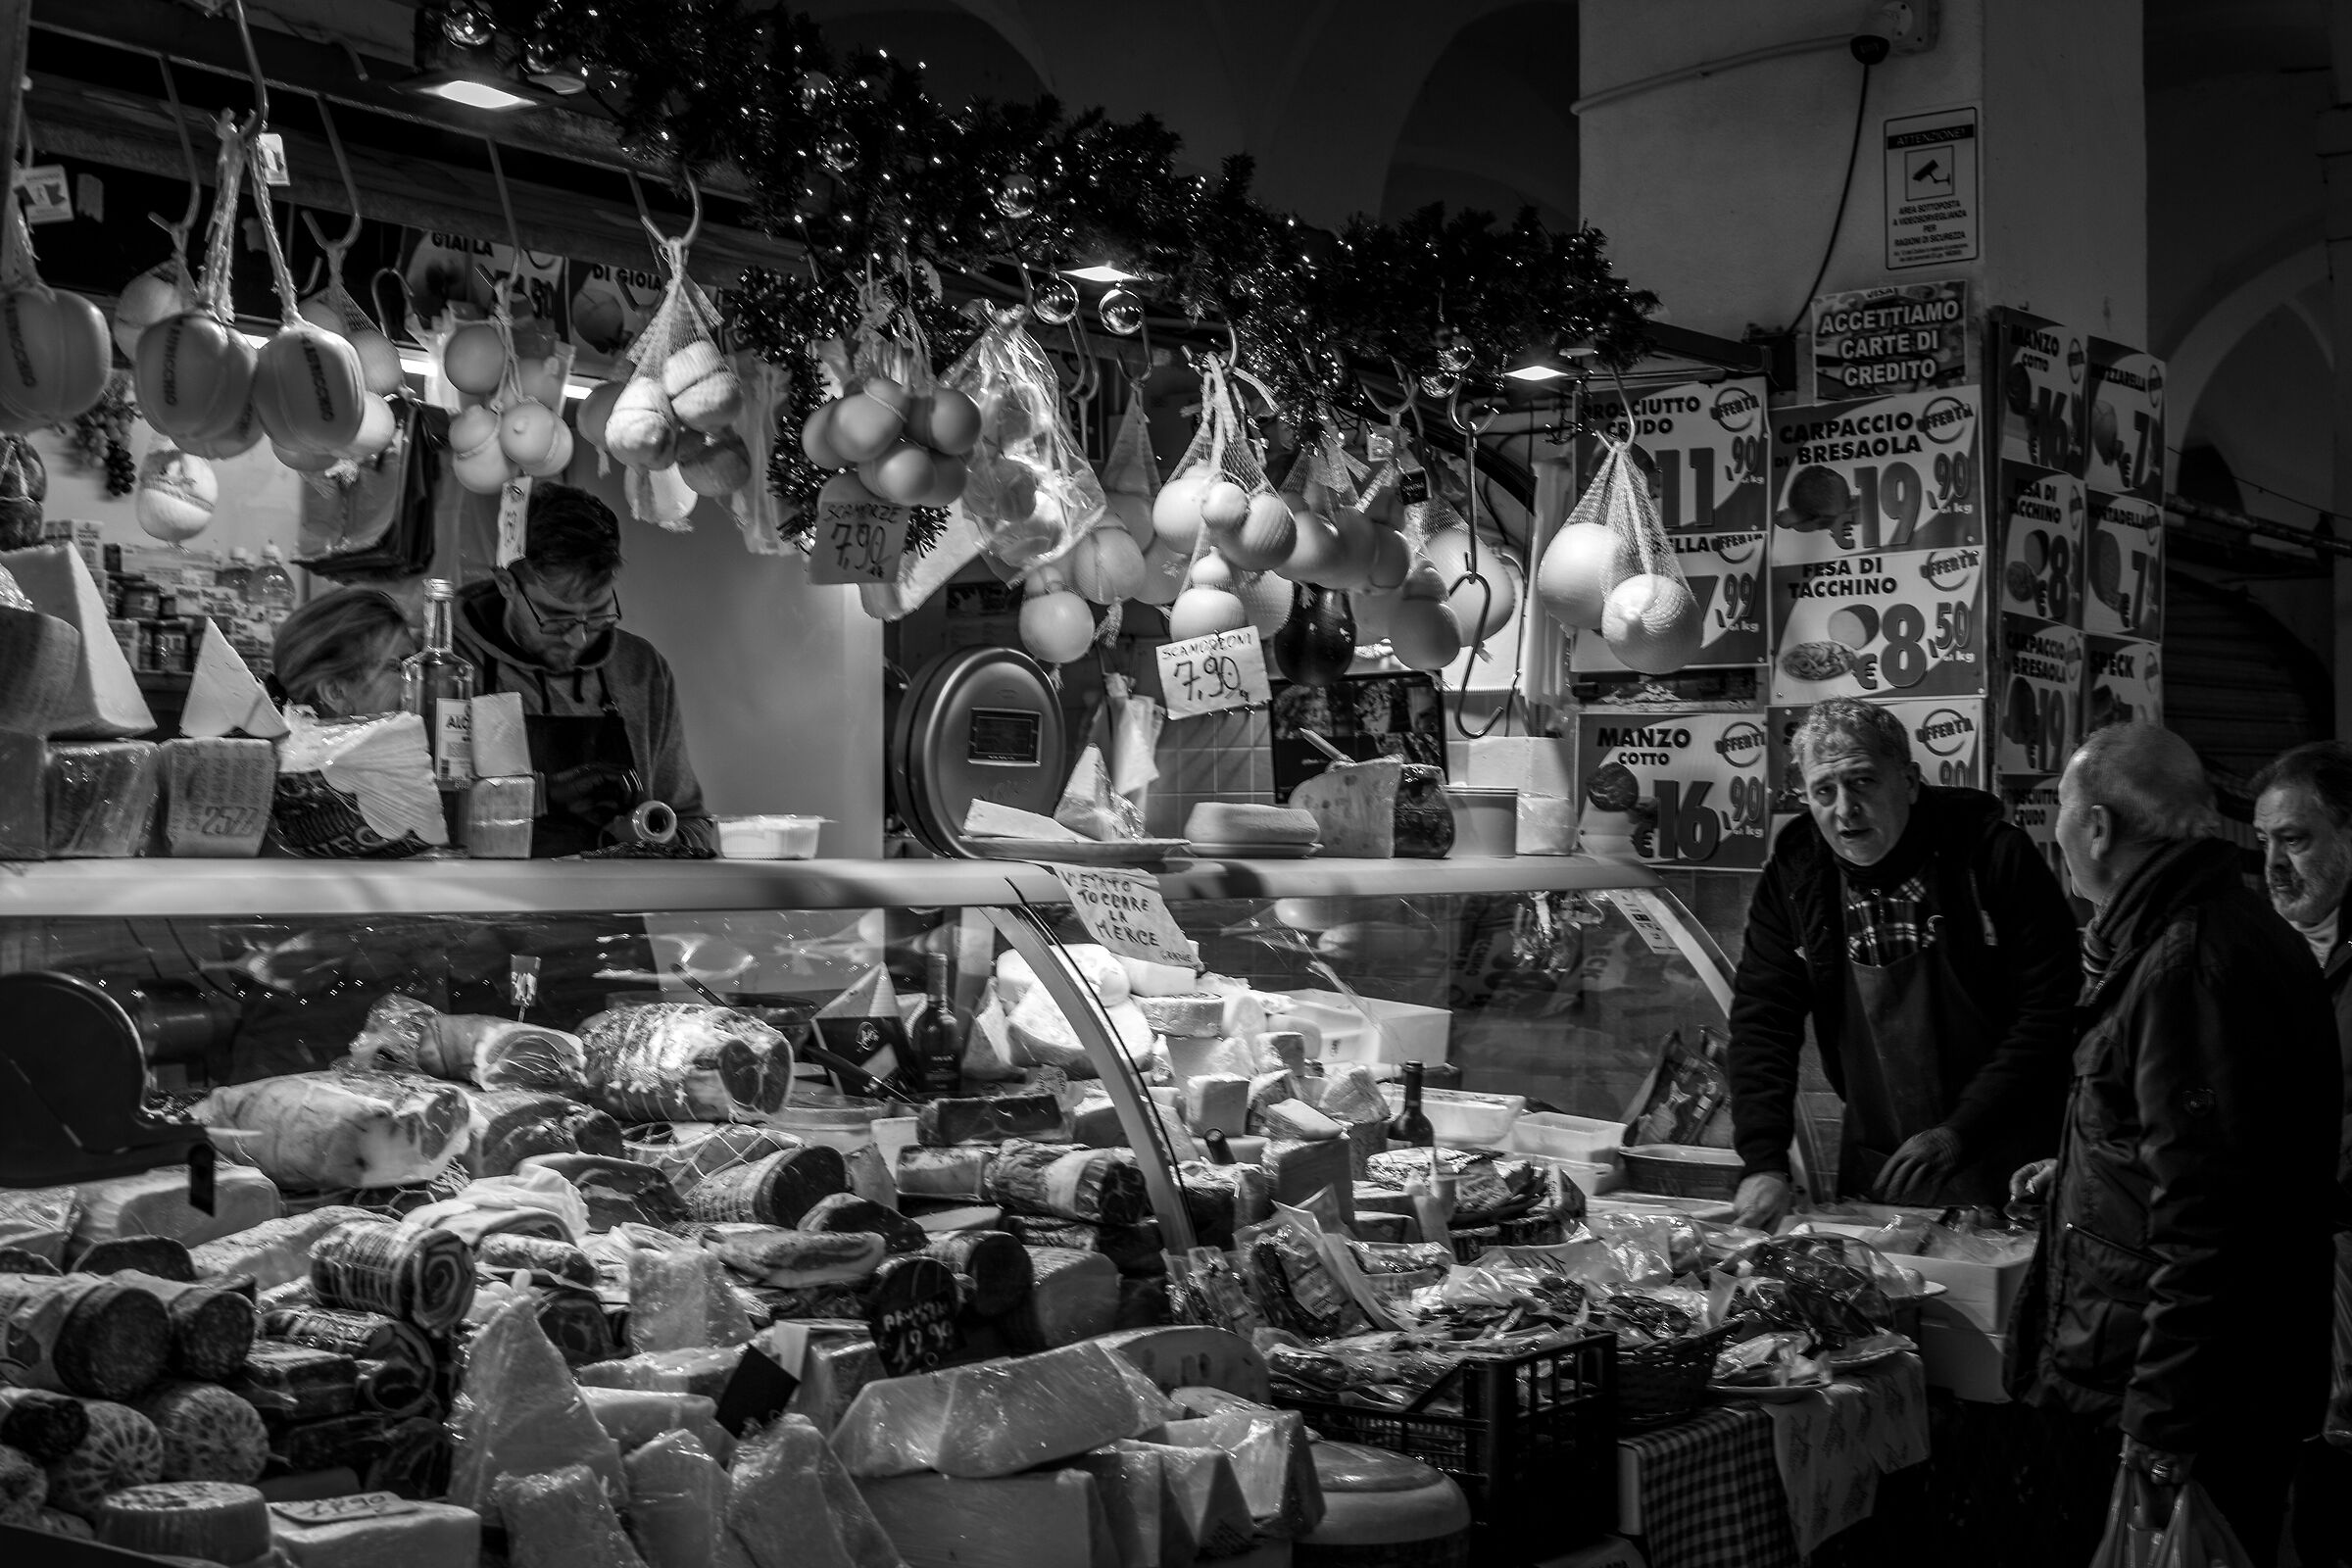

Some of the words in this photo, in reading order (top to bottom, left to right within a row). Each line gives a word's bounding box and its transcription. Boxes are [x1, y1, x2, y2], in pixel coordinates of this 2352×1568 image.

[594, 264, 610, 281] DI
[1820, 300, 1960, 334] ACCETTIAMO
[1840, 333, 1911, 360] CARTE
[1917, 330, 1939, 351] DI
[2011, 323, 2059, 357] MANZO
[1843, 358, 1937, 387] CREDITO
[1779, 413, 1914, 445] CARPACCIO
[1797, 435, 1922, 466] BRESAOLA
[1803, 560, 1852, 578] FESA
[1860, 557, 1882, 574] DI
[1788, 576, 1897, 599] TACCHINO
[2090, 650, 2134, 679] SPECK
[1596, 727, 1690, 748] MANZO
[1618, 752, 1669, 765] COTTO
[1077, 889, 1151, 913] TOCCARE
[1108, 909, 1130, 924] LA
[1095, 919, 1161, 948] MERCE
